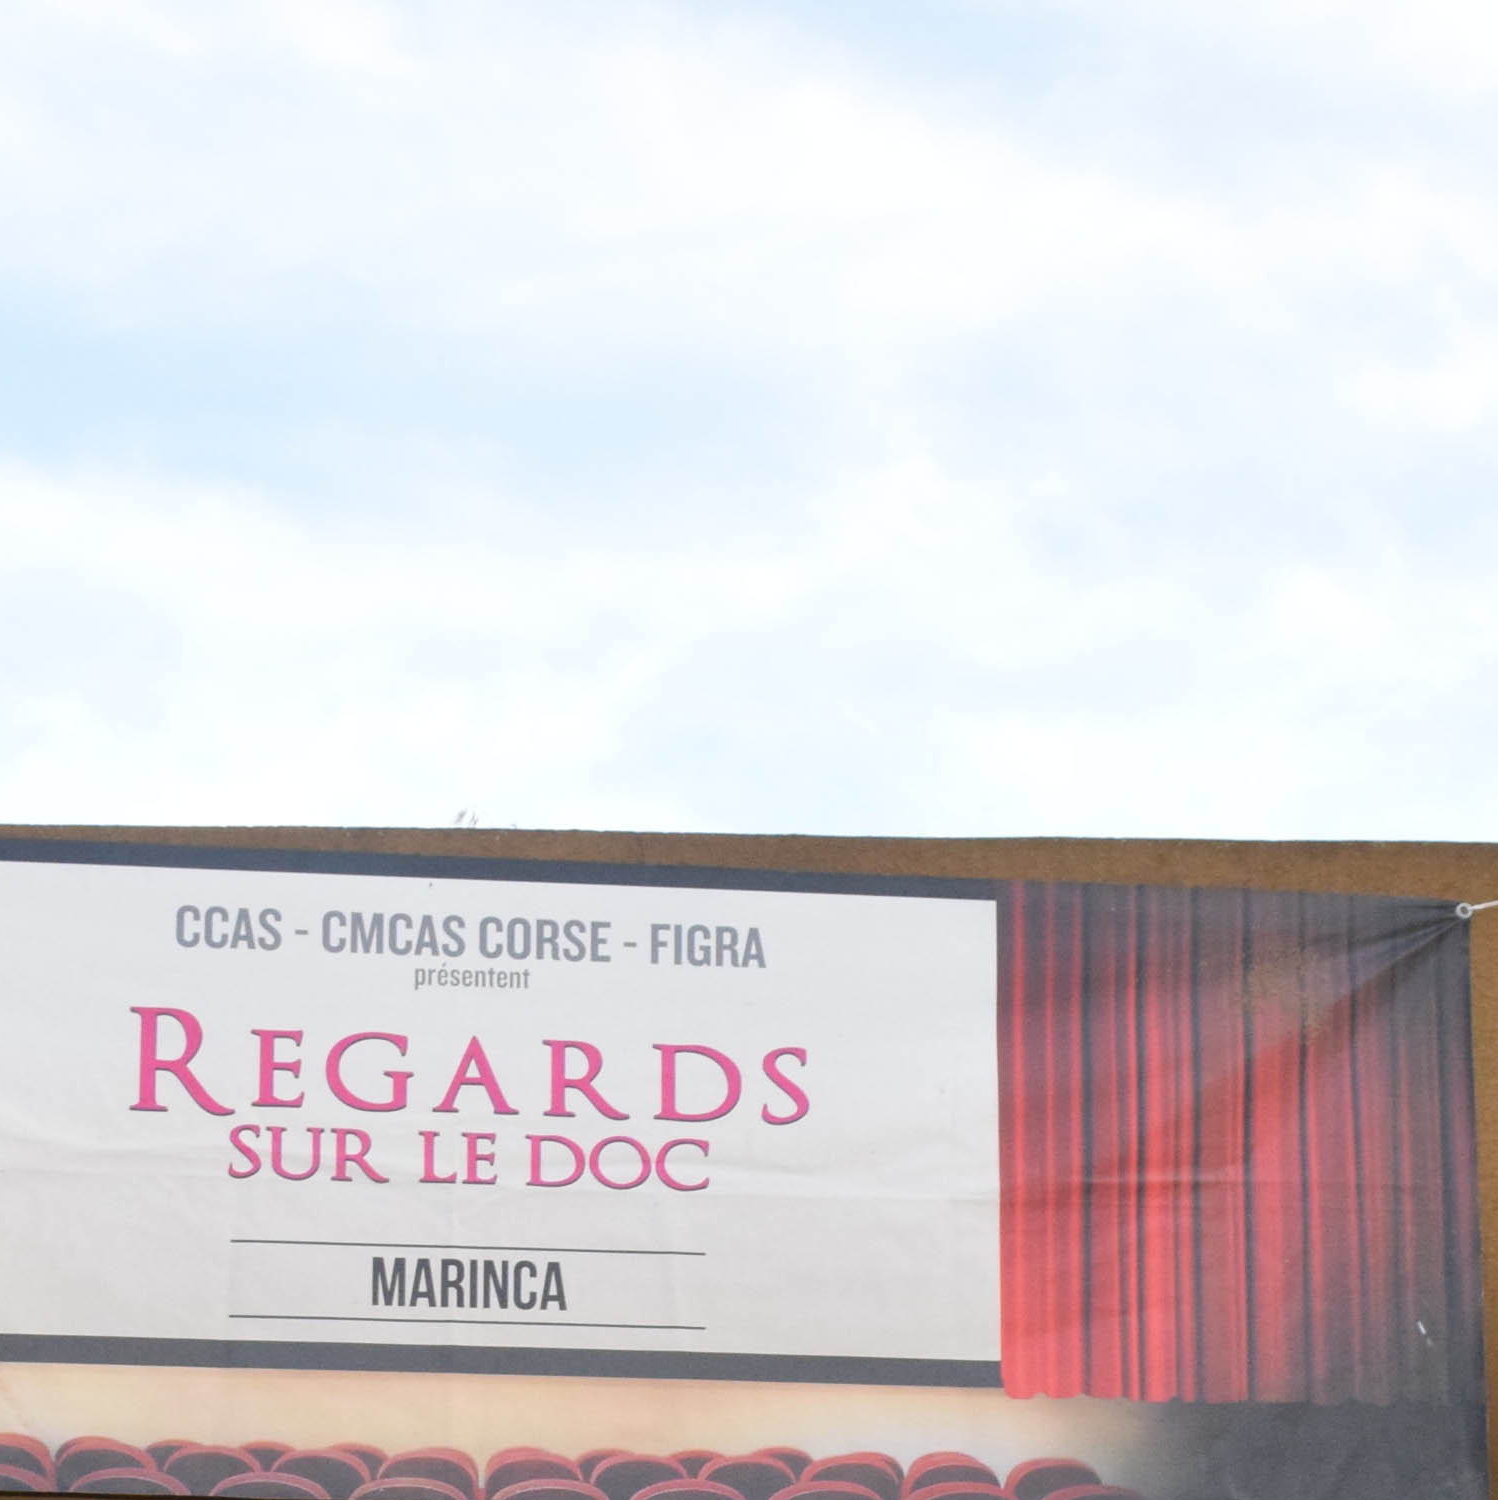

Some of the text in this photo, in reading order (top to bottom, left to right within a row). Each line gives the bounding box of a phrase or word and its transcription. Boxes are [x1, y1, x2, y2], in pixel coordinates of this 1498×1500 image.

[175, 905, 283, 951] CCAS
[322, 911, 467, 959] CMCAS
[478, 917, 612, 963] CORSE
[650, 924, 767, 970] FIGRA
[414, 963, 530, 991] présentent
[130, 1006, 810, 1126] REGARDS
[228, 1124, 711, 1192] SUR LE DOC
[371, 1258, 568, 1312] MARINCA
